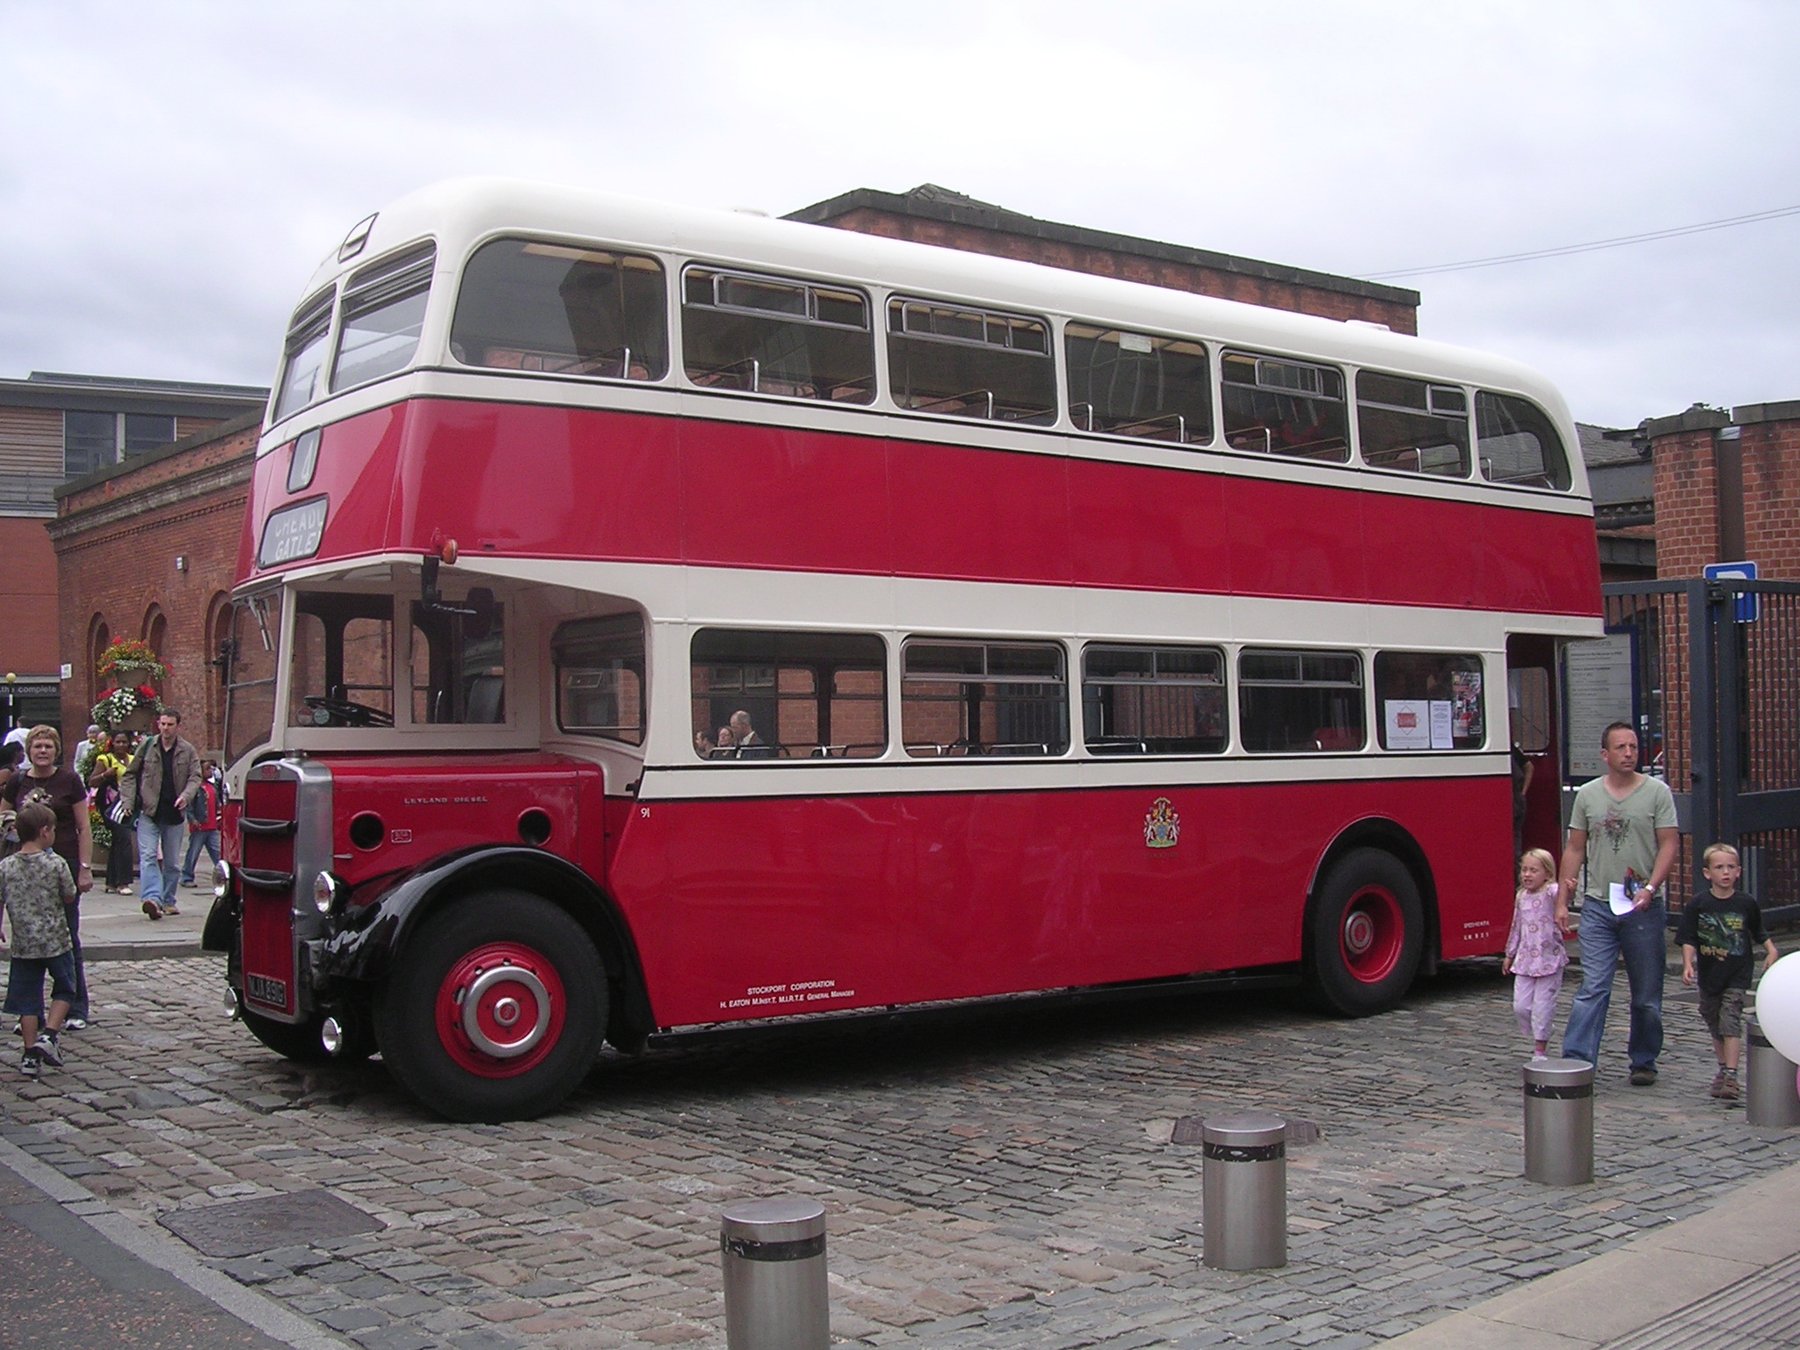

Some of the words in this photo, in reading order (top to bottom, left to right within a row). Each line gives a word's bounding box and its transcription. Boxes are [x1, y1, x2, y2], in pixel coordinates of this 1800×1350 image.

[17, 685, 57, 694] complete
[640, 807, 650, 818] 91
[747, 984, 787, 996] STOCKPORT
[790, 980, 835, 991] CORPORATION
[728, 999, 751, 1008] EATON
